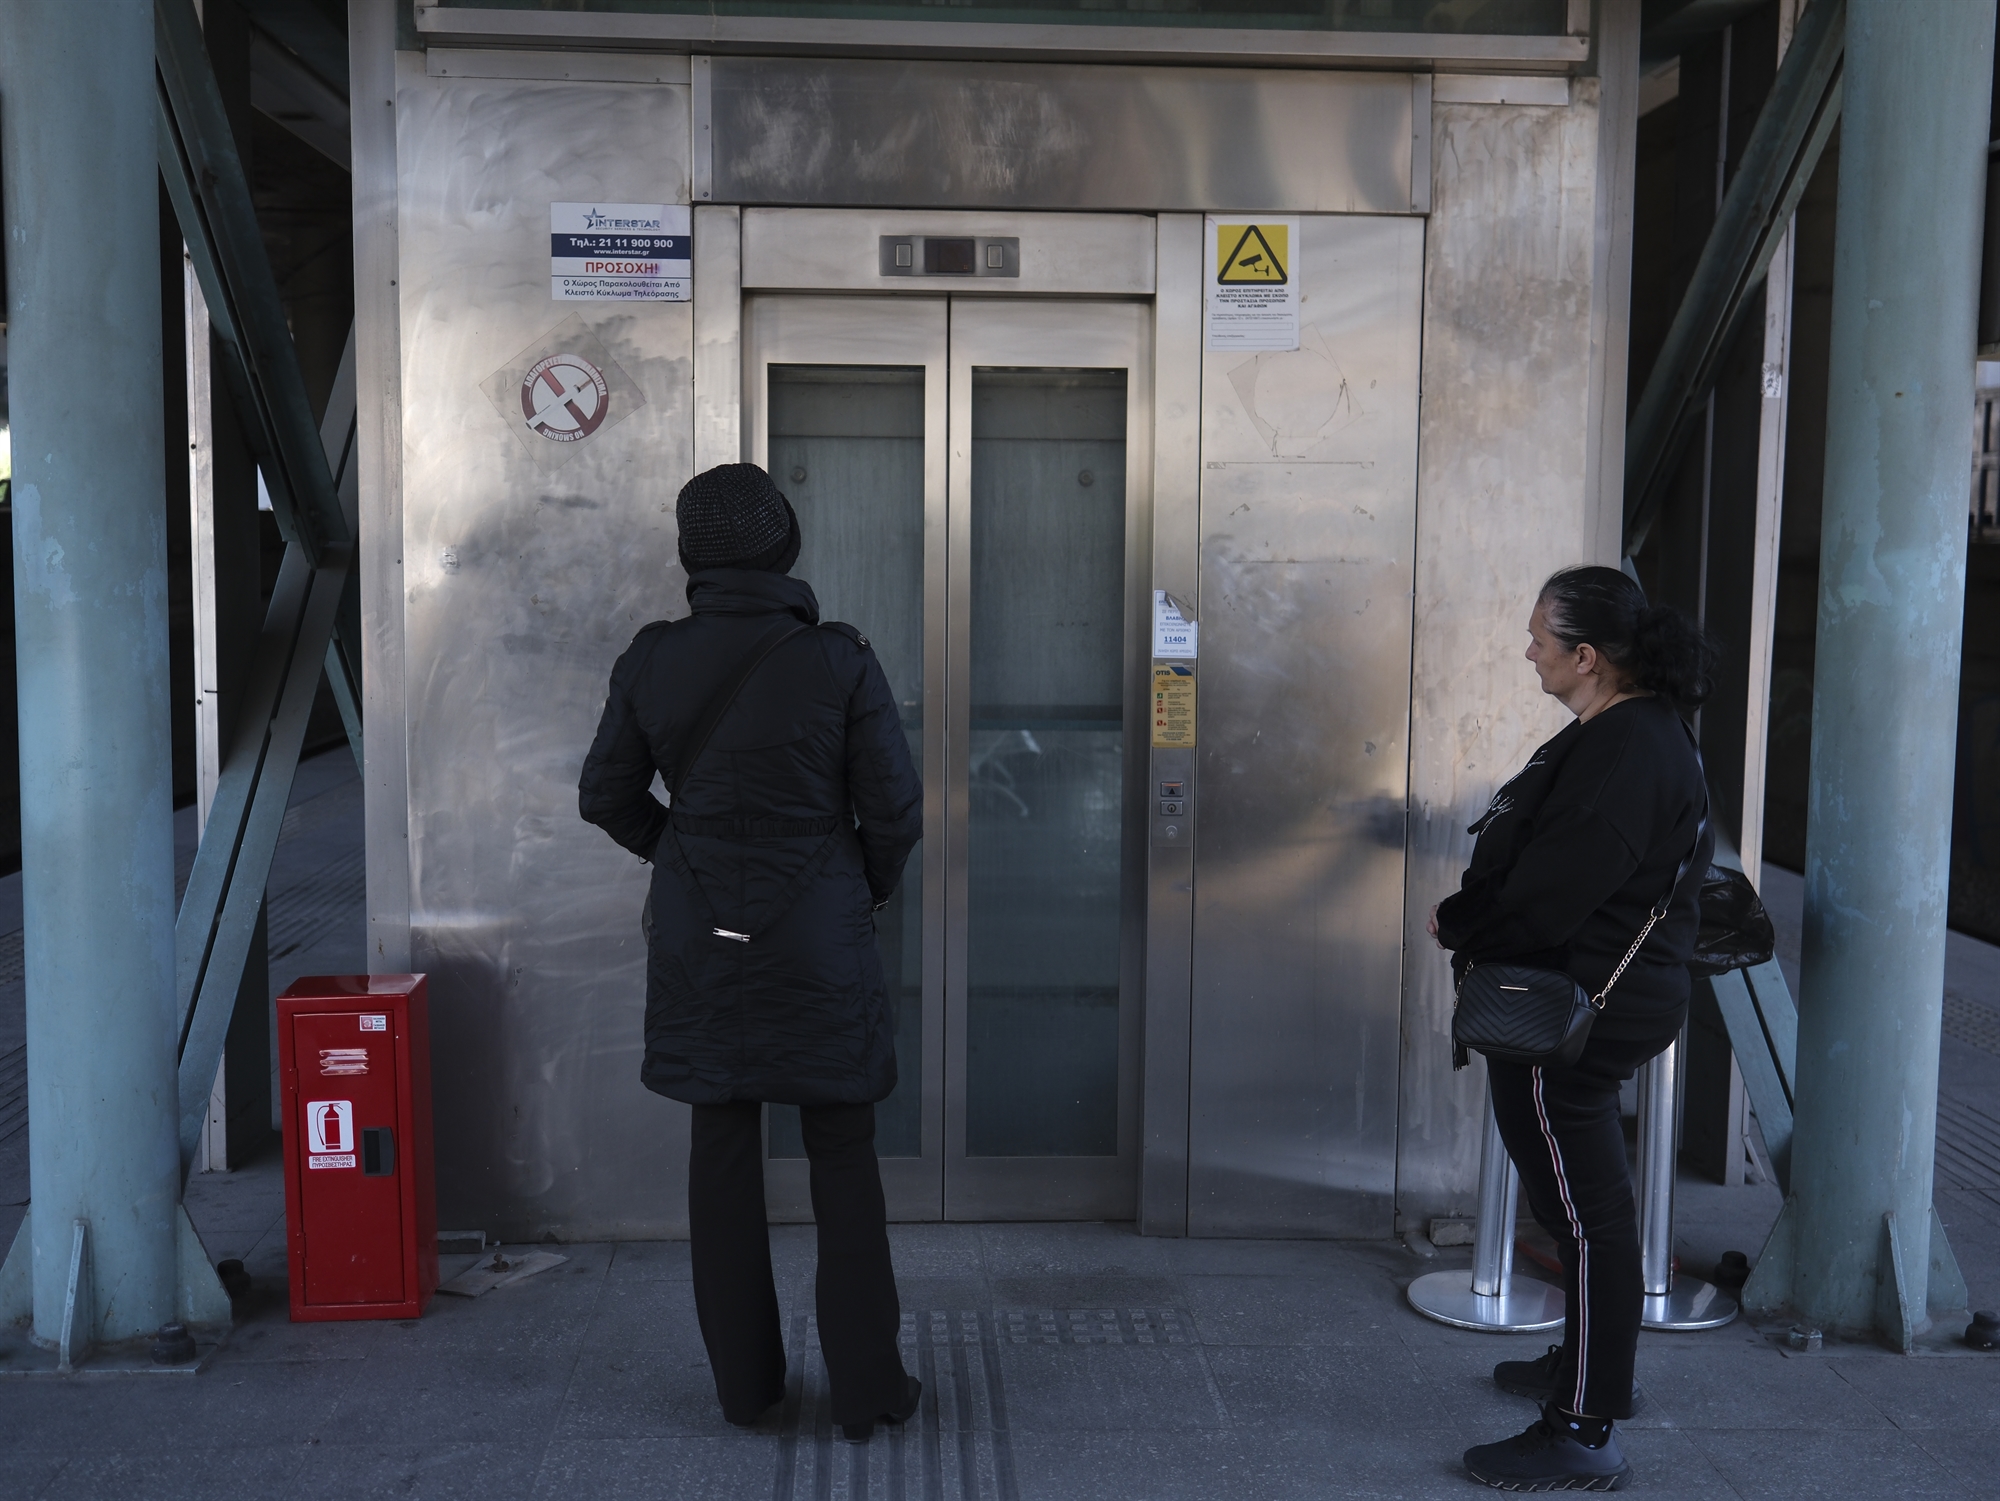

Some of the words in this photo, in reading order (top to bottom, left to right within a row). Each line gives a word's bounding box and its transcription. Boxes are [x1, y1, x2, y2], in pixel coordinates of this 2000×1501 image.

[595, 218, 661, 228] INTERSTAR
[570, 238, 596, 248] Τηλ.:
[599, 239, 611, 247] 21
[615, 239, 627, 247] 11
[631, 239, 651, 247] 900
[653, 239, 673, 248] 900
[585, 262, 658, 274] ΠΡΟΣΟΧΗ!
[572, 280, 597, 288] Χώρος
[542, 428, 575, 442] SMOKING
[574, 429, 585, 440] NO
